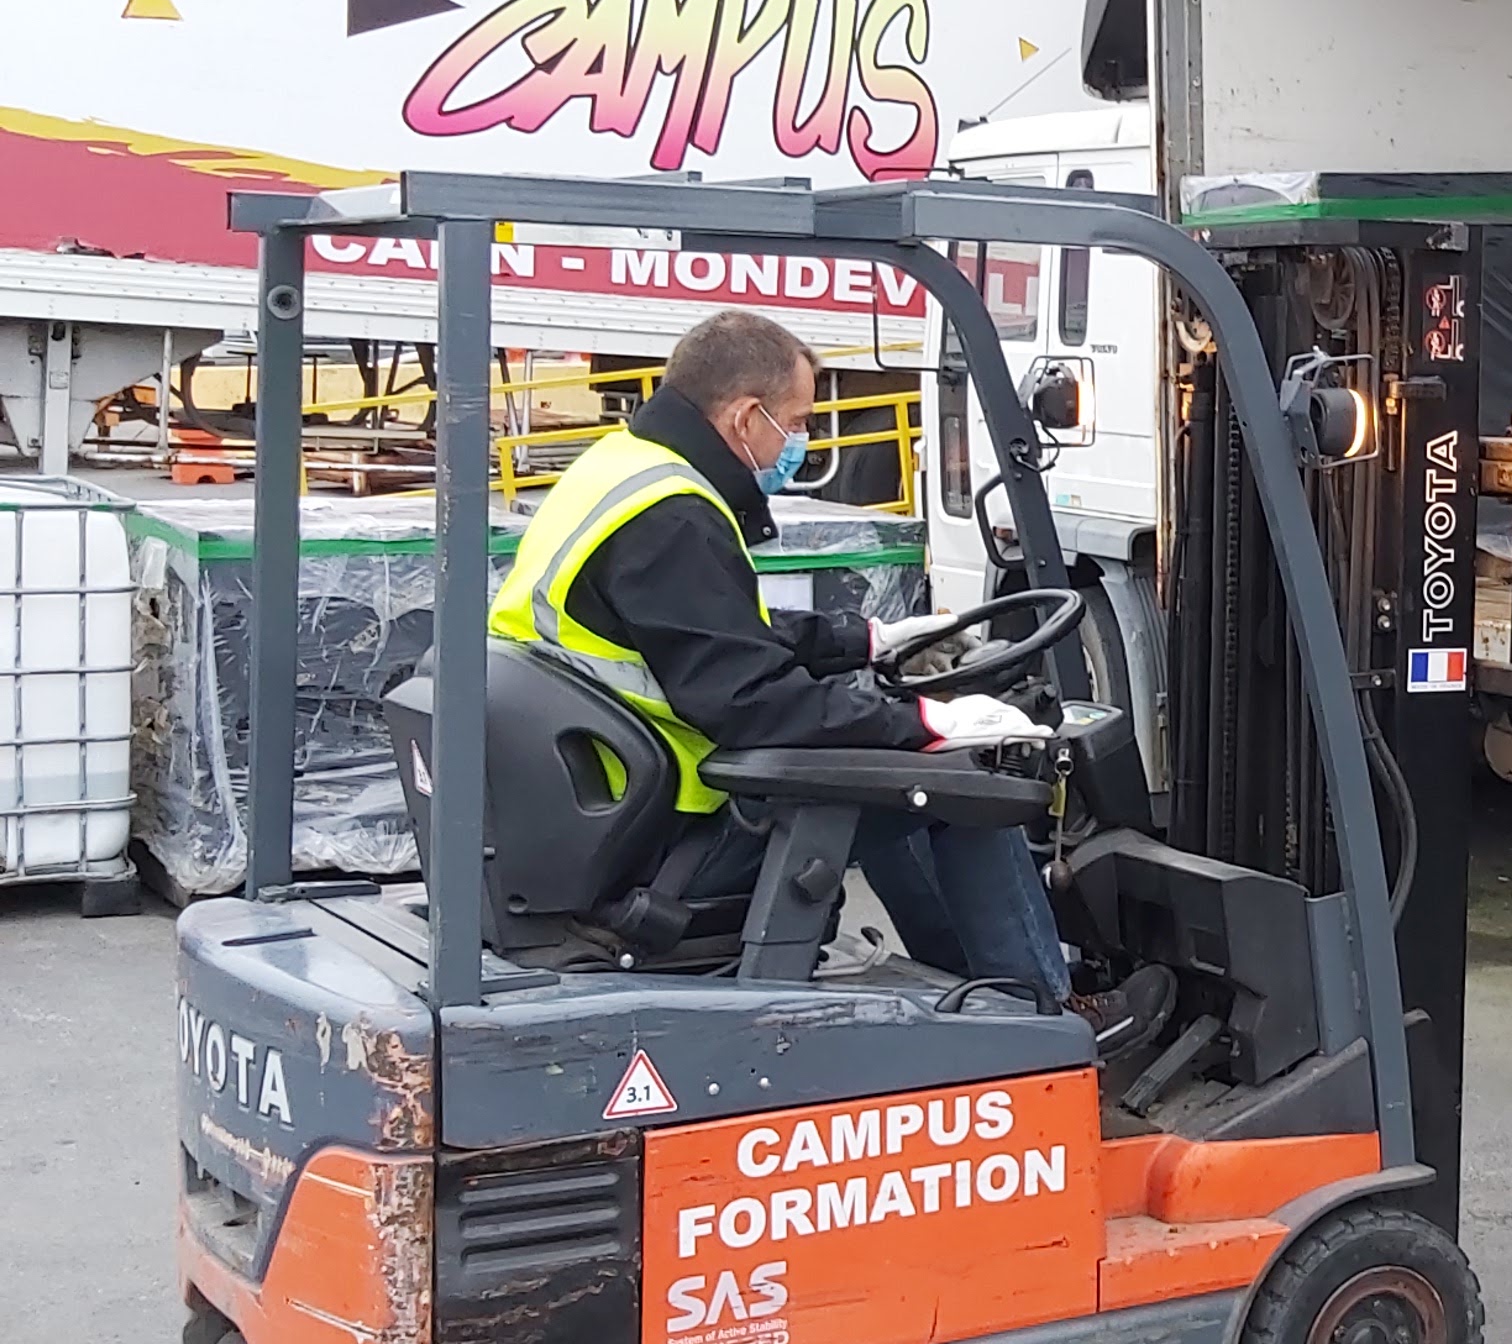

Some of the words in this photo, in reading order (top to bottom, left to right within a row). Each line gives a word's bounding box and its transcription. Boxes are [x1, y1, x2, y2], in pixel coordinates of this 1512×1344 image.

[311, 234, 535, 278] CAN
[1422, 430, 1459, 642] TOYOTA
[178, 997, 292, 1124] OYOTA
[626, 1085, 651, 1103] 3.1
[736, 1091, 1014, 1177] CAMPUS
[678, 1145, 1066, 1258] FORMATION
[666, 1261, 789, 1333] SAS
[705, 1330, 716, 1342] of
[718, 1327, 747, 1339] Active
[749, 1318, 788, 1334] Stability
